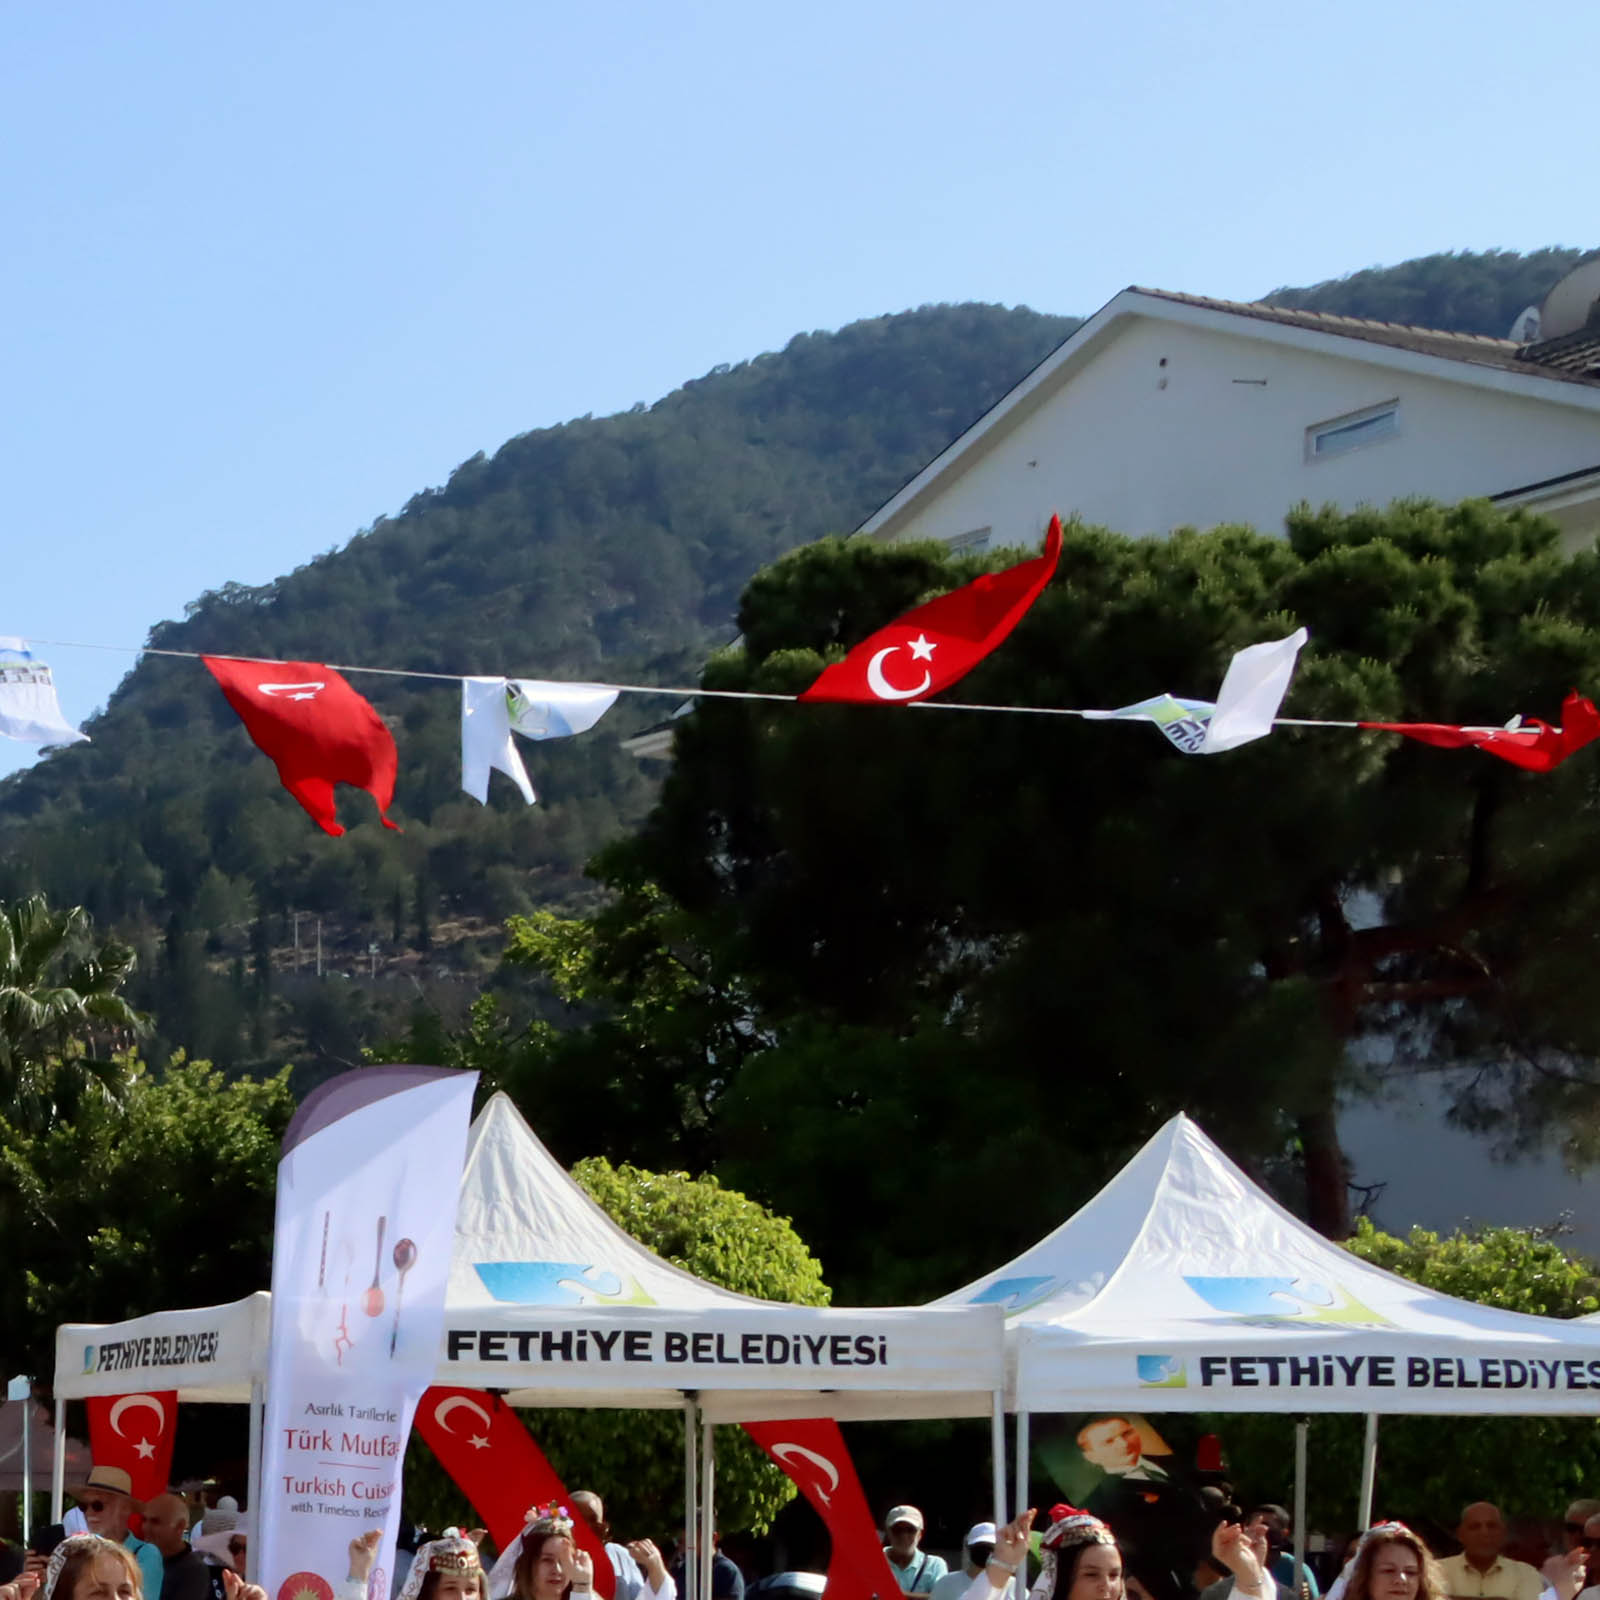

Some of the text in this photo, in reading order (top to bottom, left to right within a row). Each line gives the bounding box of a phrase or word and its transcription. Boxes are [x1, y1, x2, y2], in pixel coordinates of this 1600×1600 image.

[283, 1429, 333, 1451] Türk
[282, 1476, 346, 1497] Turkish
[291, 1502, 313, 1514] with
[318, 1502, 361, 1518] Timeless
